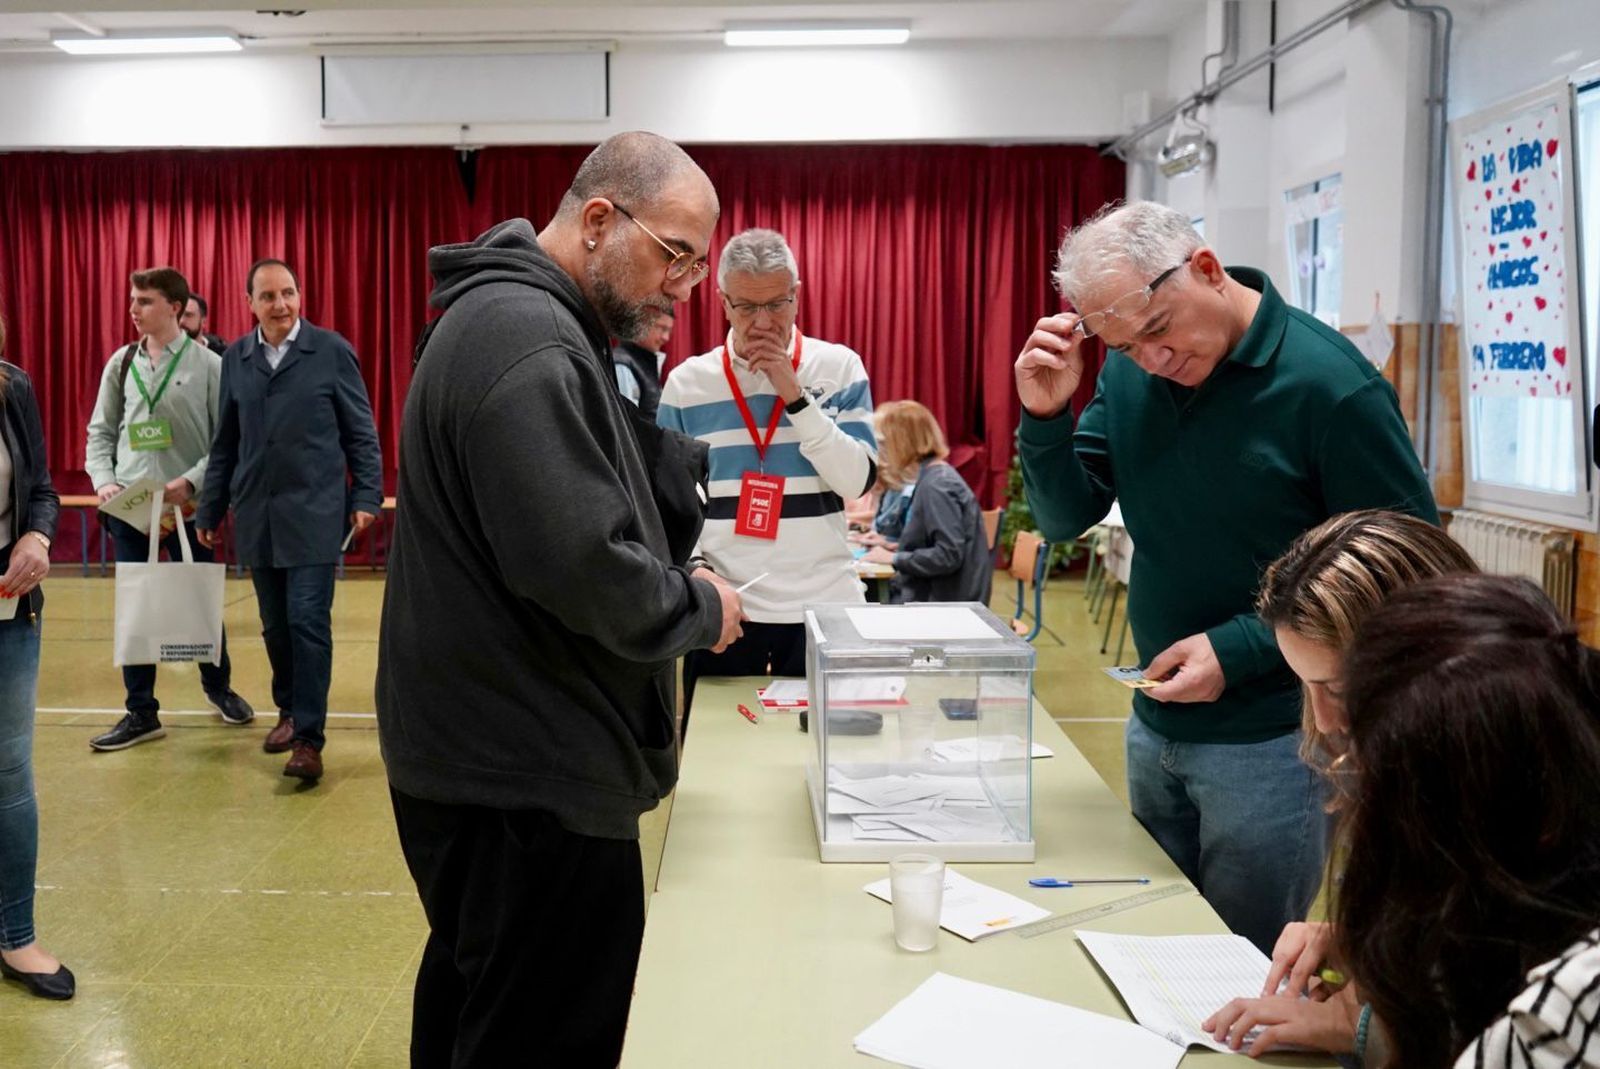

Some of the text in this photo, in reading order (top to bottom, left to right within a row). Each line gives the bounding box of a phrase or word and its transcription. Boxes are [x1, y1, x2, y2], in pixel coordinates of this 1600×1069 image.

[1481, 139, 1543, 183] LA VIDA
[1491, 200, 1537, 235] MEJOR
[1487, 256, 1539, 291] AMIGOS
[136, 426, 162, 438] VOX
[752, 498, 769, 507] PSOE
